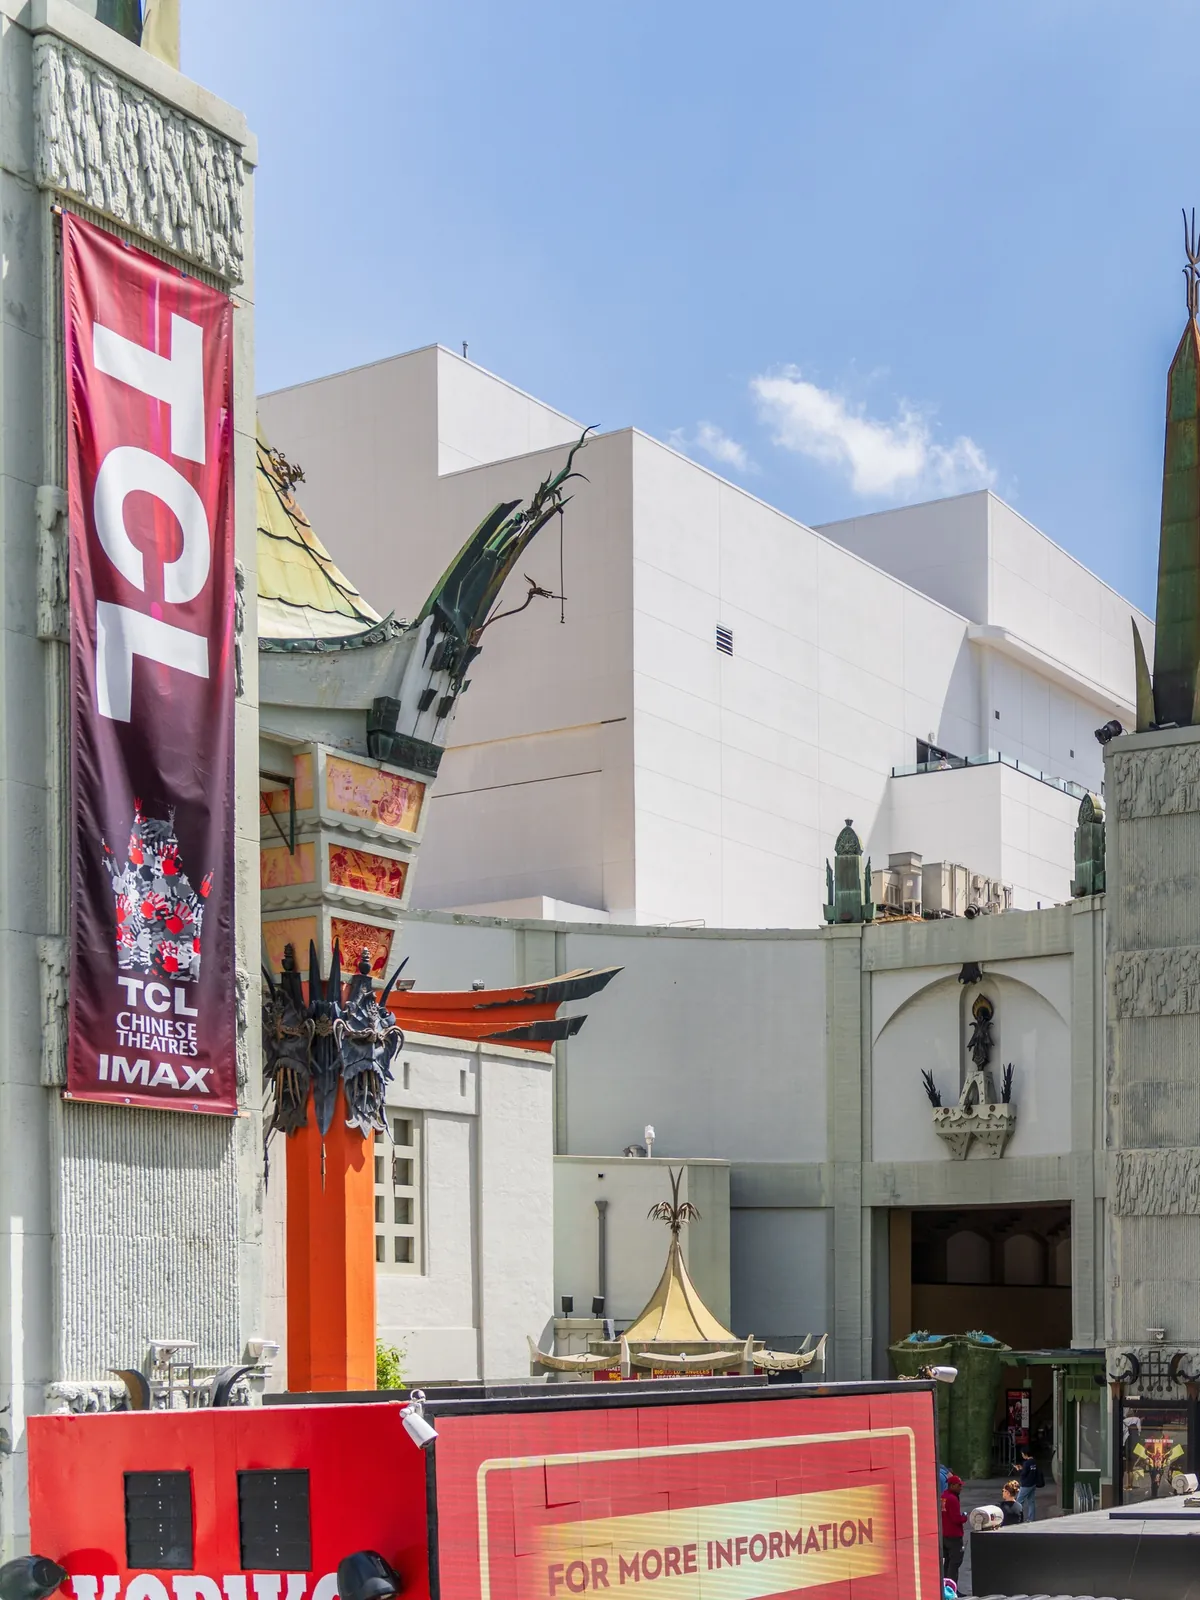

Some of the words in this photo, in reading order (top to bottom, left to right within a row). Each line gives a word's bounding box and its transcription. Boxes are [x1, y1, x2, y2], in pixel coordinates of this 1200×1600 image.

[93, 312, 211, 723] TCL
[117, 975, 199, 1018] TCL
[116, 1011, 198, 1041] CHINESE
[116, 1029, 199, 1057] THEATRES
[98, 1053, 211, 1093] IMAX
[547, 1557, 610, 1597] FOR
[617, 1543, 698, 1585] MORE
[706, 1517, 874, 1570] INFORMATION
